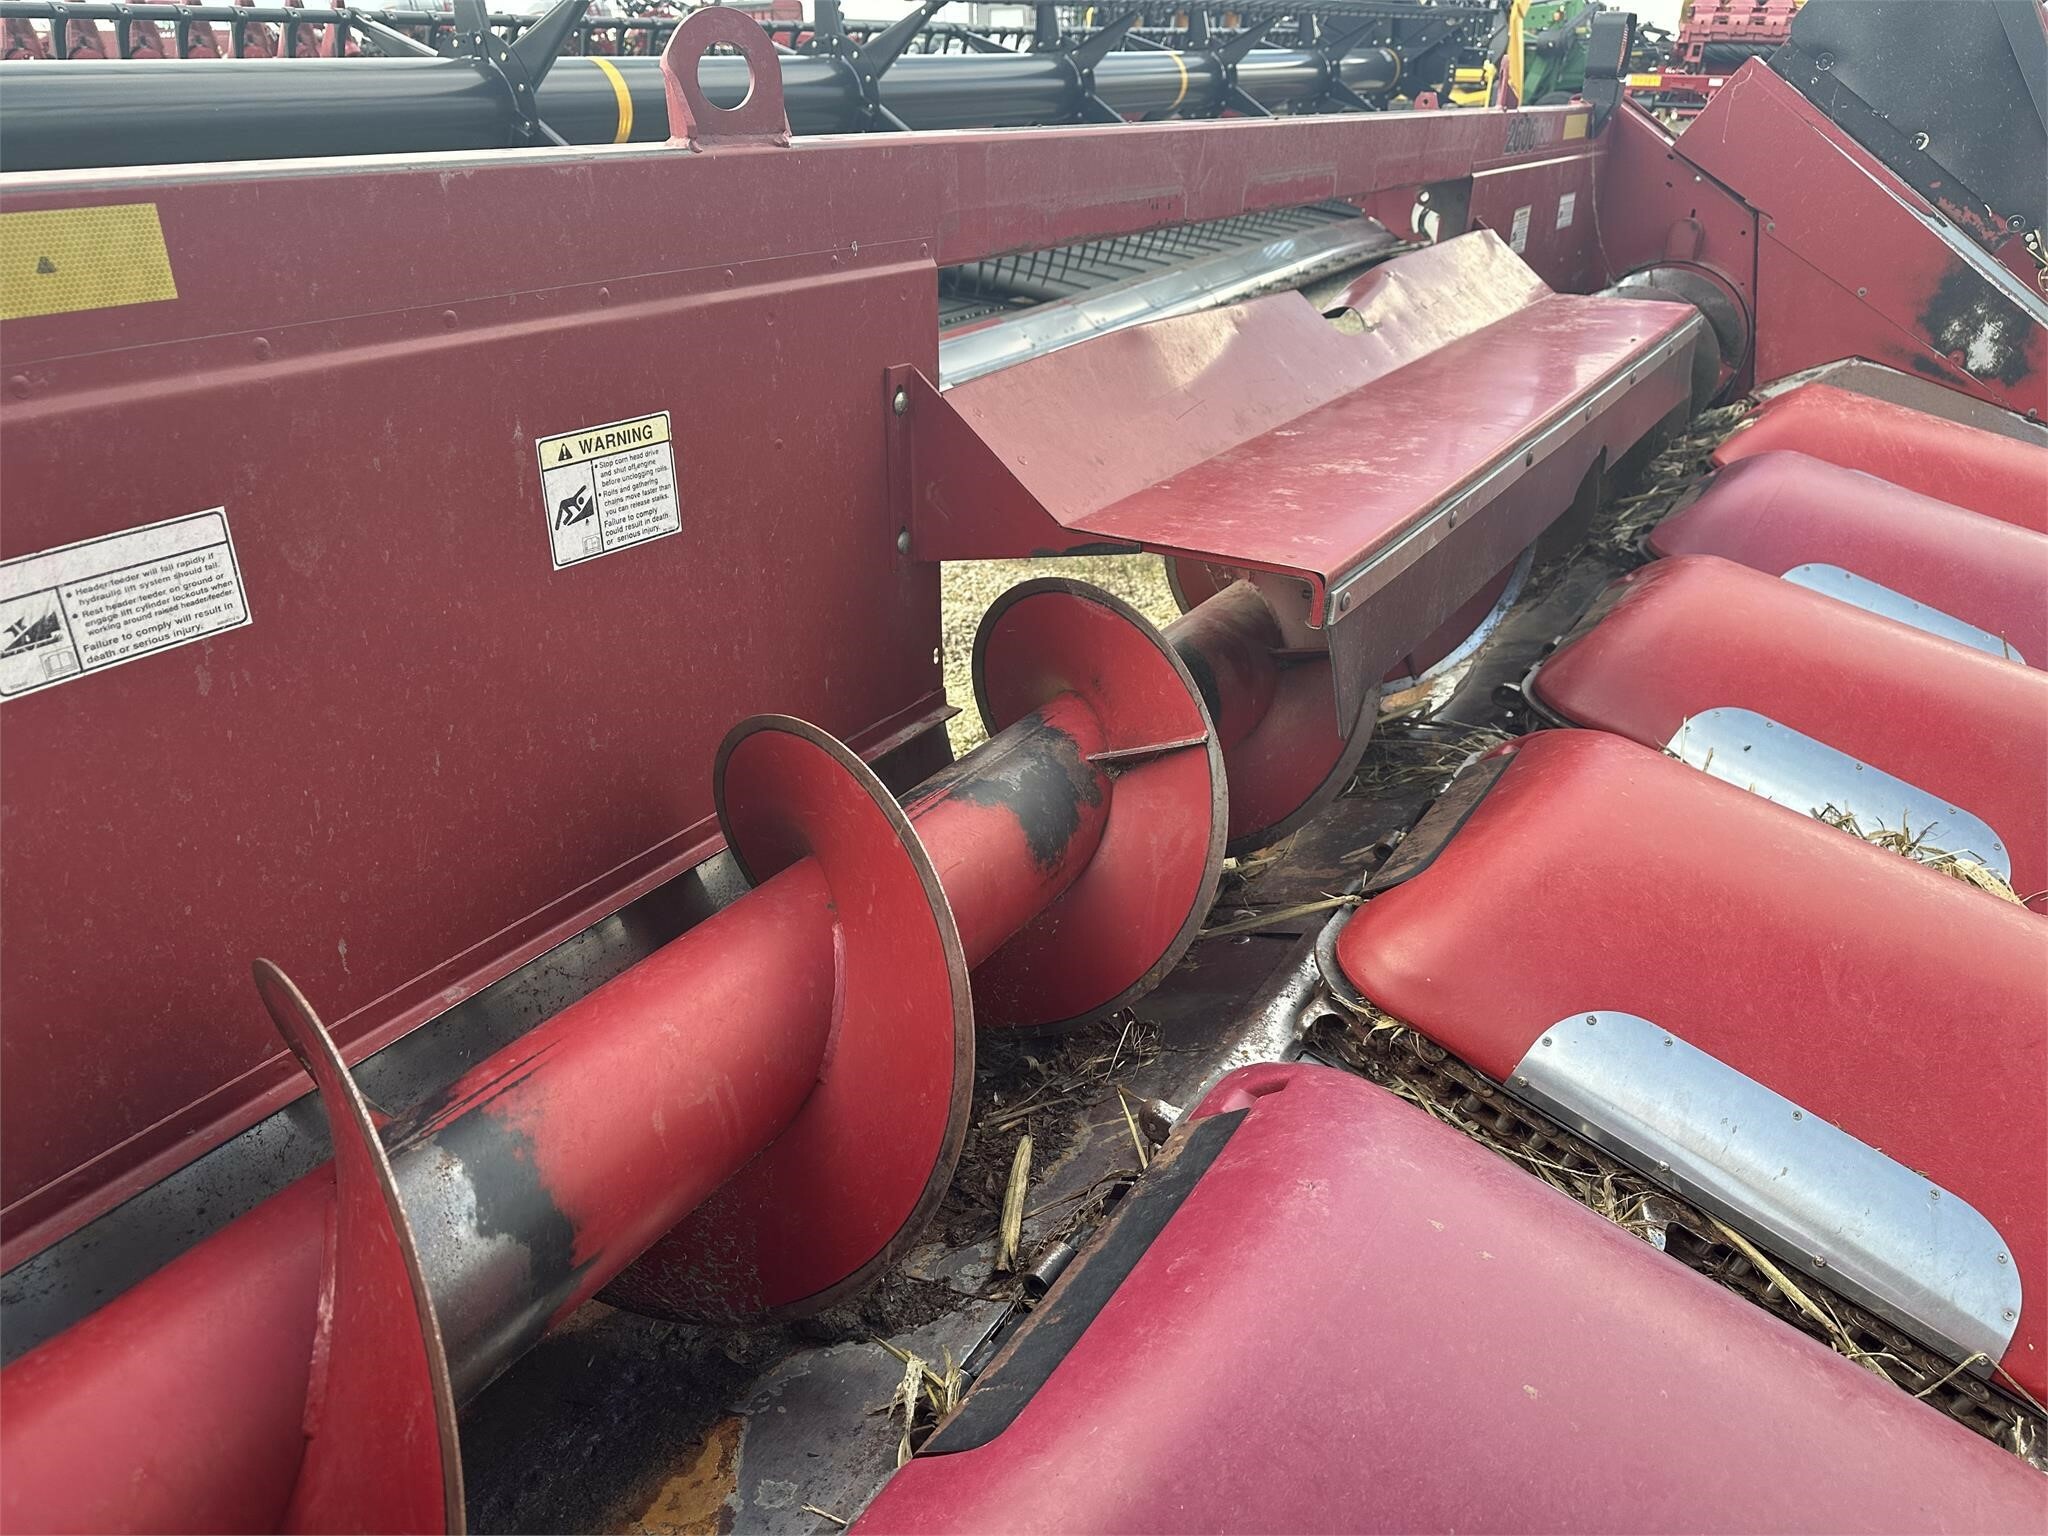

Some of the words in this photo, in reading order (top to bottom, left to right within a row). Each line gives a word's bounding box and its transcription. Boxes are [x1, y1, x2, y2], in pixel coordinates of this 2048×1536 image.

[578, 424, 653, 455] WARNING
[599, 460, 614, 469] Stop
[614, 457, 628, 465] corn
[629, 452, 644, 461] head
[644, 449, 659, 458] drive
[600, 469, 612, 478] and
[613, 466, 627, 475] shut
[601, 478, 621, 488] before
[621, 469, 654, 482] unclogging
[603, 489, 619, 498] Rolls
[620, 485, 631, 493] and
[631, 478, 659, 492] gathering
[604, 497, 624, 507] chains
[625, 492, 641, 501] move
[642, 487, 658, 496] faster
[658, 483, 671, 492] than
[604, 517, 626, 528] Failure
[635, 507, 658, 519] comply
[605, 508, 617, 518] you
[618, 505, 629, 513] can
[630, 499, 650, 509] release
[605, 525, 624, 537] could
[625, 520, 643, 531] result
[606, 538, 613, 546] or
[617, 530, 641, 543] serious
[142, 568, 158, 577] will
[160, 563, 174, 573] fall
[176, 556, 206, 568] rapidly
[208, 552, 214, 560] if
[78, 589, 122, 606] hydraulic
[124, 584, 137, 593] lift
[139, 576, 171, 589] system
[173, 566, 203, 580] should
[82, 606, 104, 618] Rest
[169, 585, 181, 593] on
[182, 575, 213, 591] ground
[85, 613, 119, 627] engage
[120, 608, 133, 617] lift
[135, 598, 170, 613] cylinder
[172, 587, 209, 602] lockouts
[210, 580, 233, 591] when
[83, 637, 119, 653] Failure
[121, 633, 133, 641] to
[135, 621, 172, 638] comply
[174, 613, 192, 625] will
[194, 605, 222, 619] result
[87, 622, 121, 636] working
[123, 611, 153, 626] around
[154, 604, 179, 616] raised
[119, 645, 130, 654] or
[132, 633, 171, 650] serious
